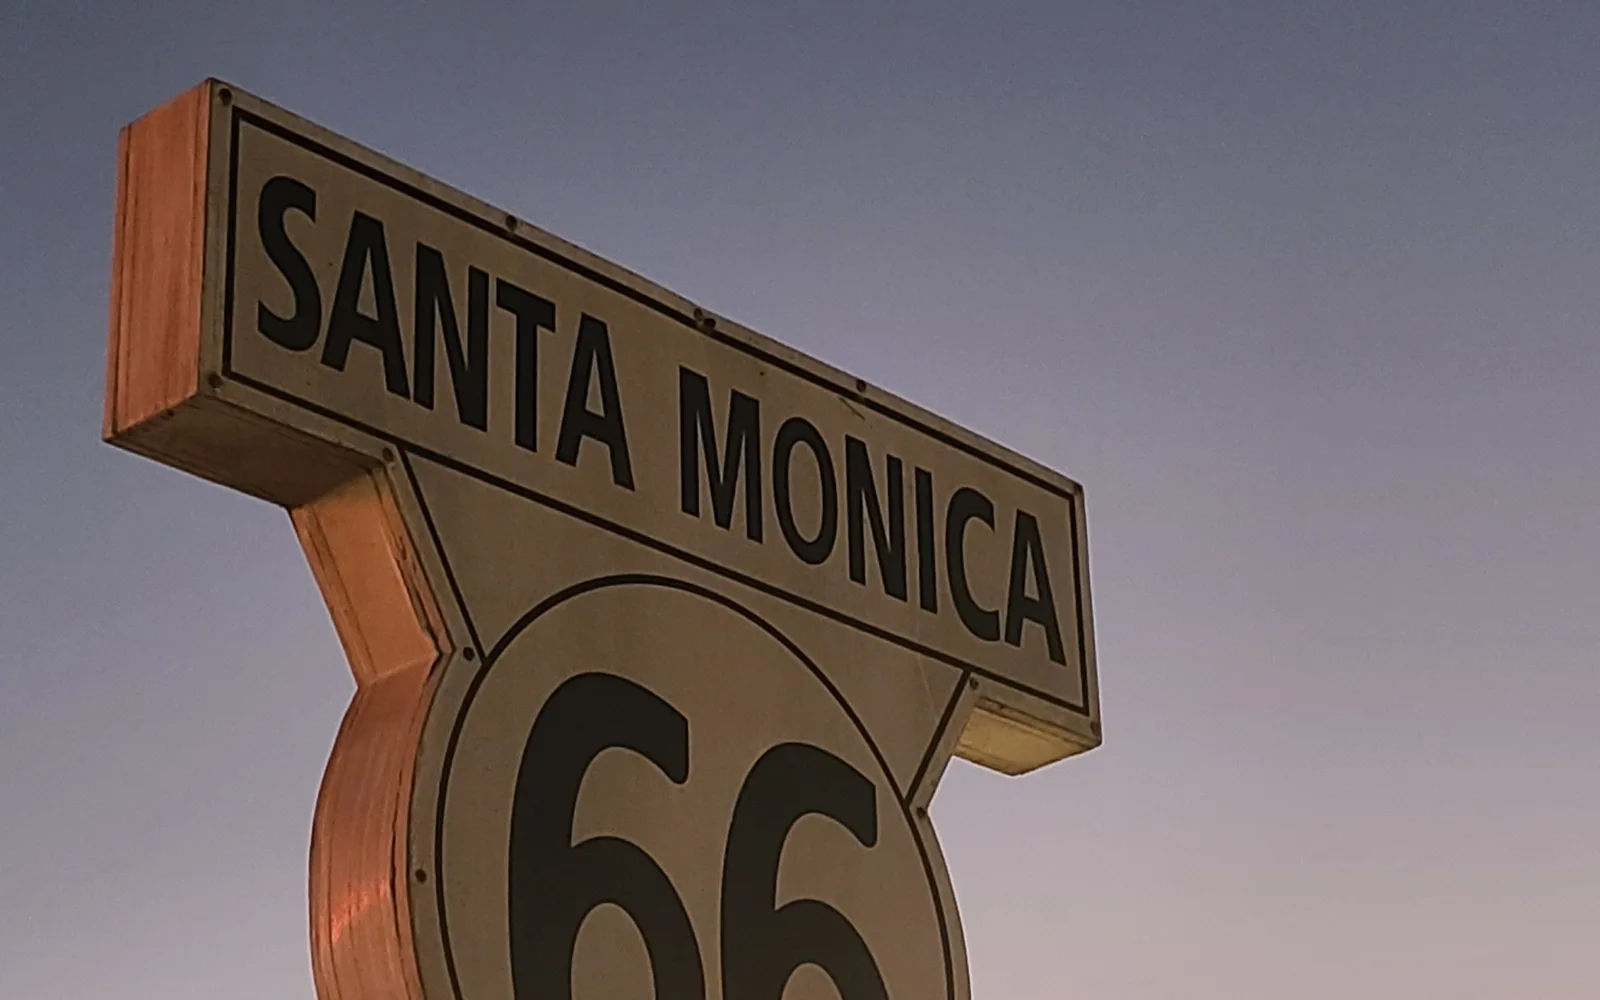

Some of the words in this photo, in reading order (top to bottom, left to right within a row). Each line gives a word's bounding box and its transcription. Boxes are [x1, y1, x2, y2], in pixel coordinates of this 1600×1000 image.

[255, 175, 635, 492] SANTA
[679, 364, 1067, 667] MONICA
[508, 671, 889, 1000] 66
